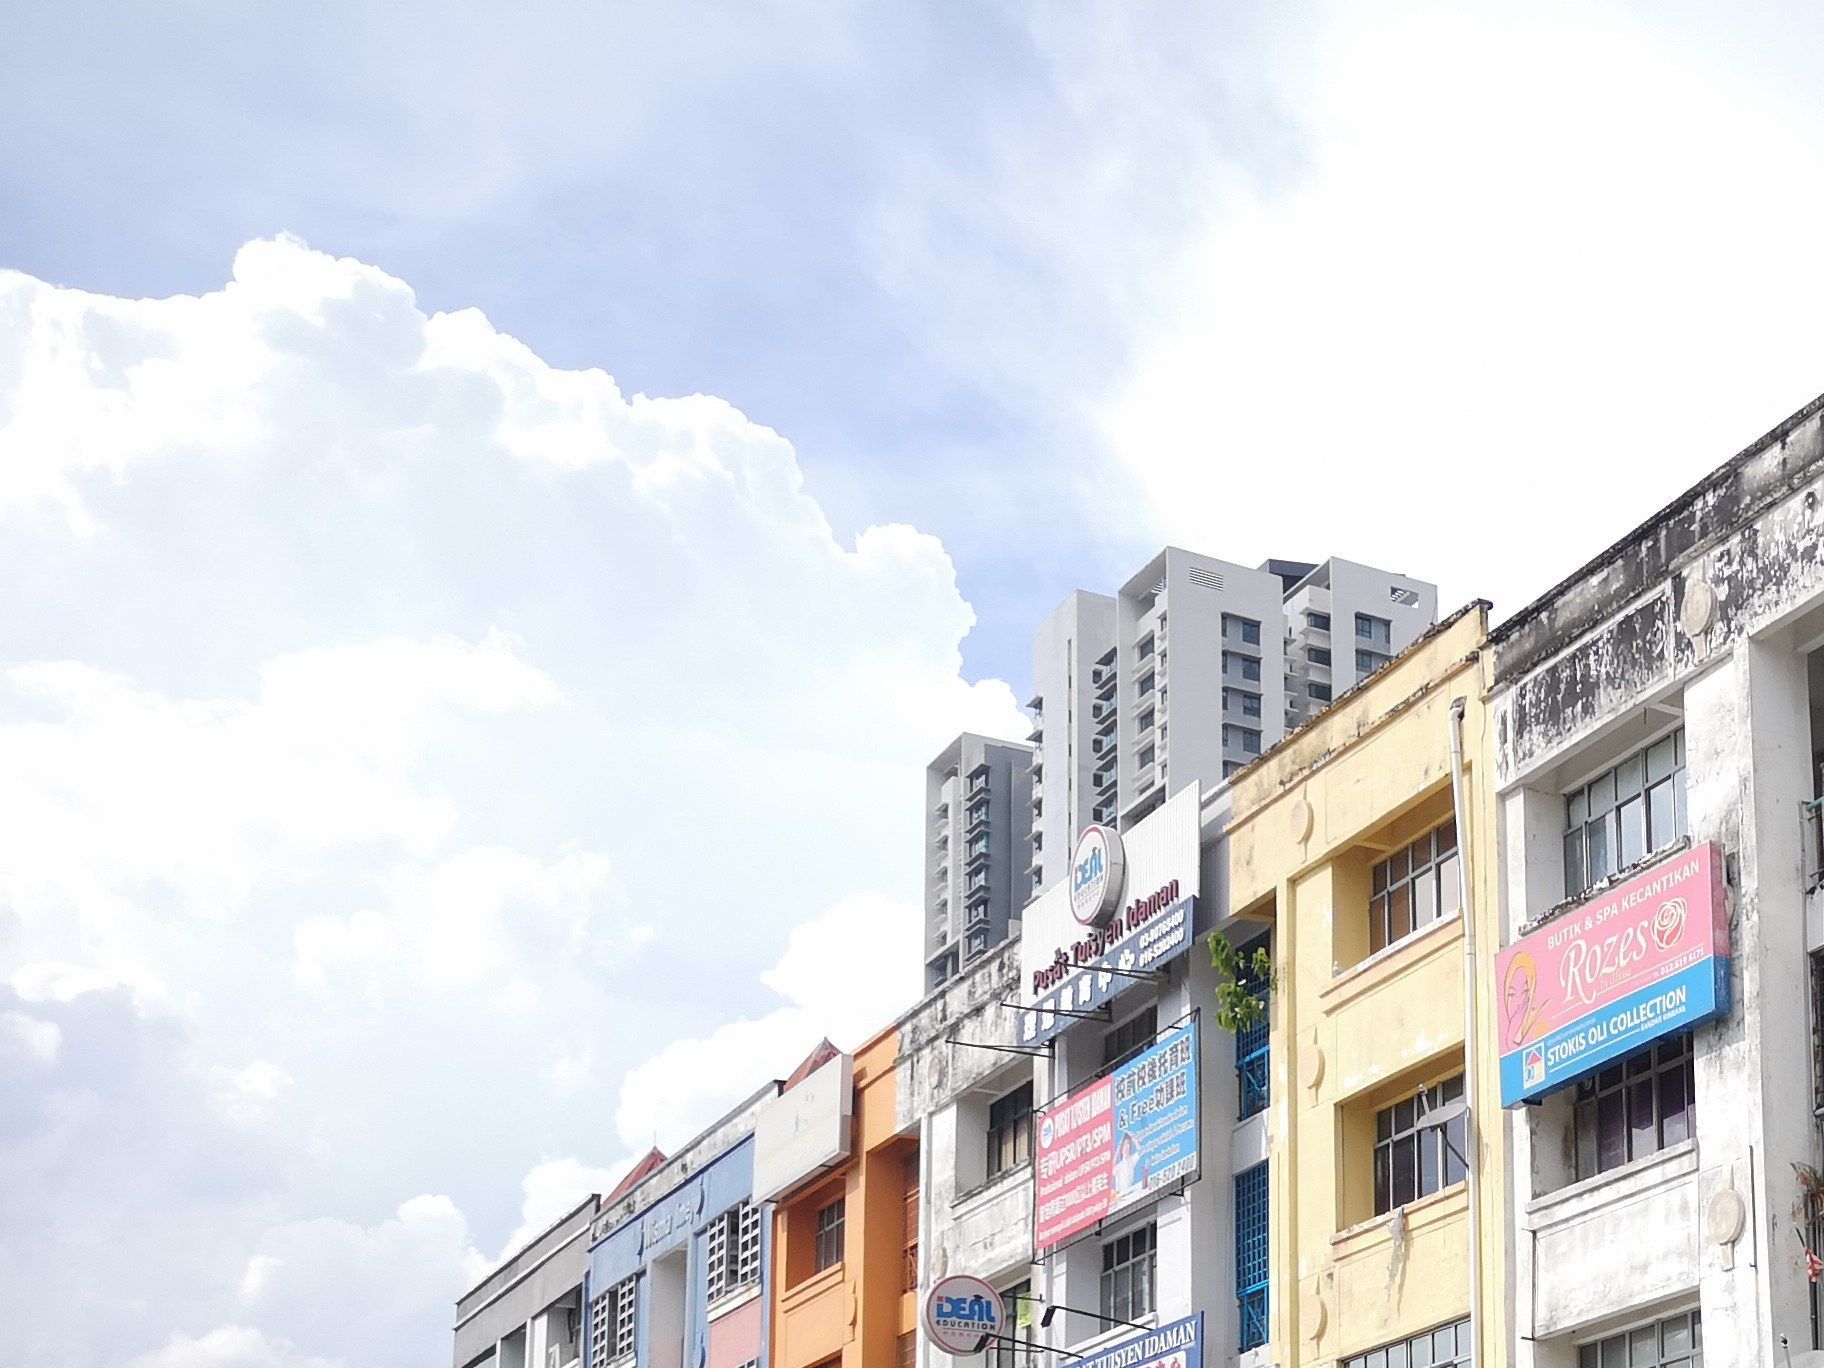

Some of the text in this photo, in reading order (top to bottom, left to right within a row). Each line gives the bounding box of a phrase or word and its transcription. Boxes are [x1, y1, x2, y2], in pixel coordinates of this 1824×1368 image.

[1547, 859, 1701, 950] BUTIK & SPA KECANTIKAN
[1547, 1032, 1587, 1067] STOKIS
[1587, 1020, 1608, 1045] OLI
[1609, 984, 1687, 1035] COLLECTION
[936, 1320, 996, 1332] EDUCATION
[1145, 1320, 1197, 1358] IDAMAN
